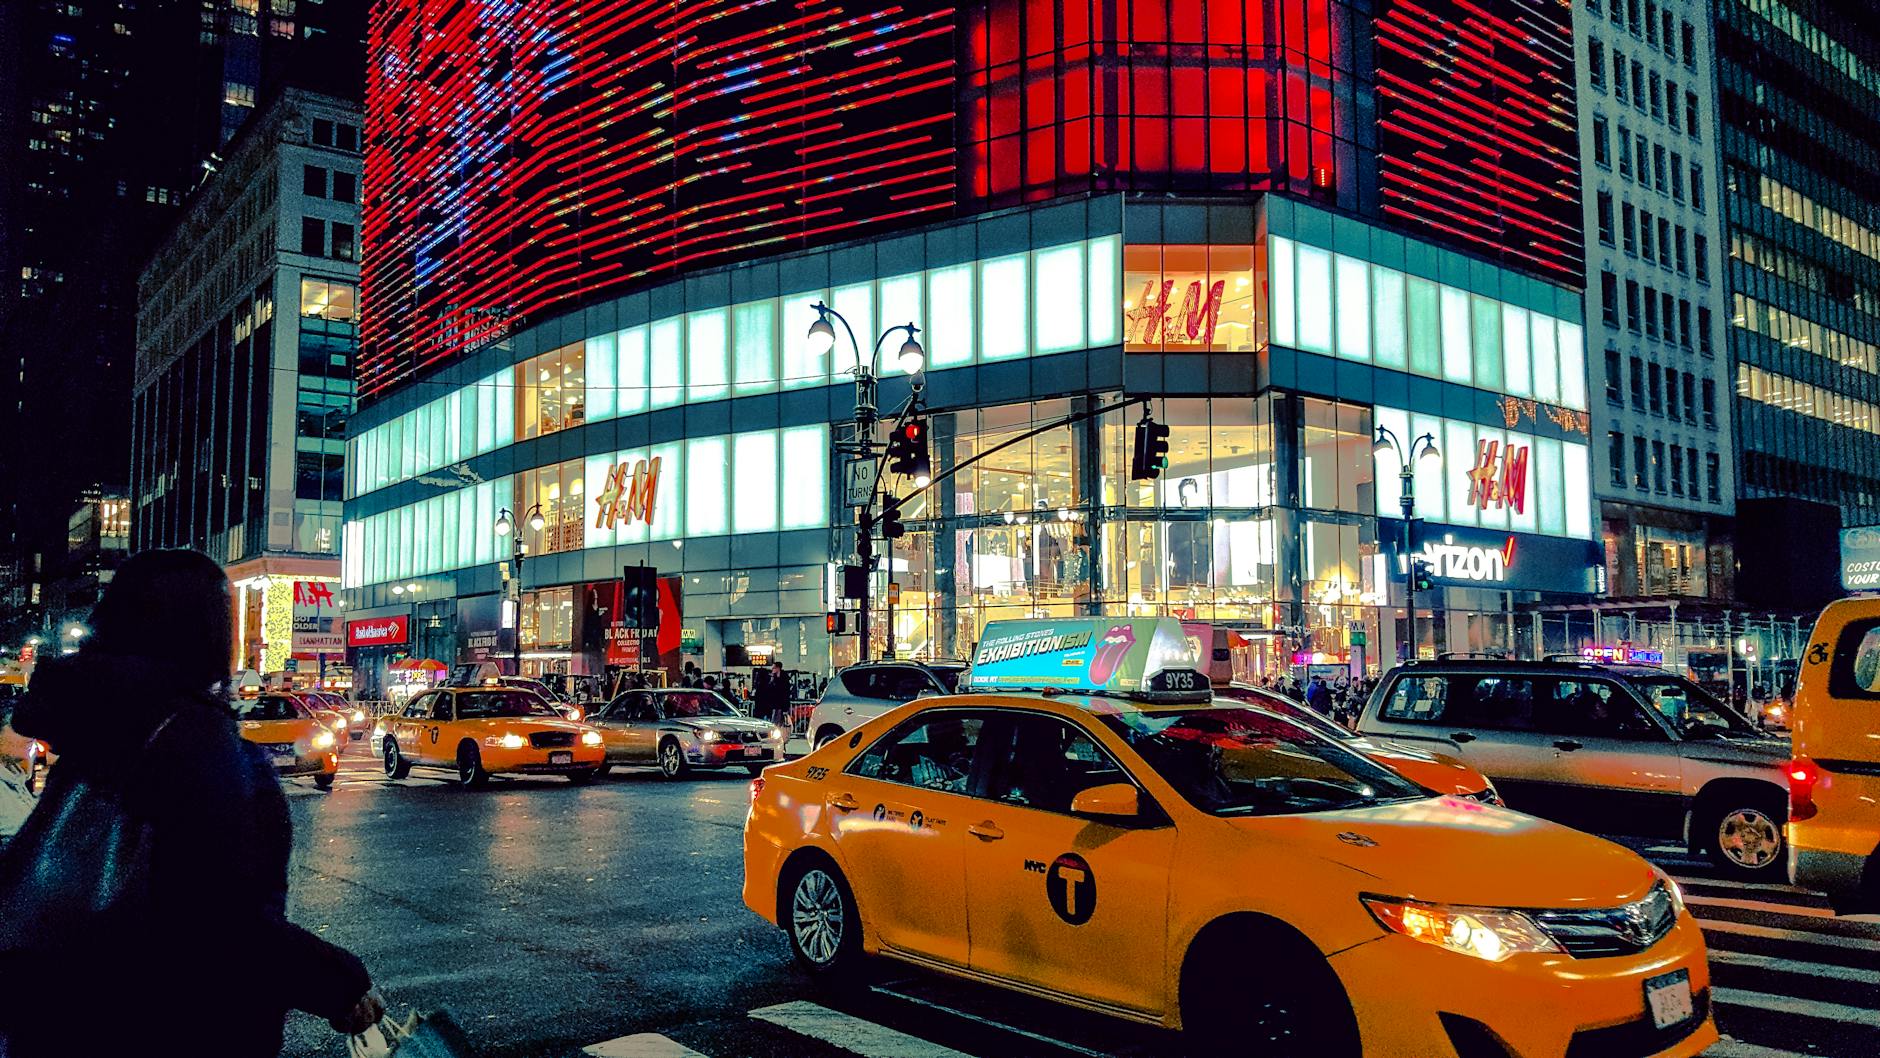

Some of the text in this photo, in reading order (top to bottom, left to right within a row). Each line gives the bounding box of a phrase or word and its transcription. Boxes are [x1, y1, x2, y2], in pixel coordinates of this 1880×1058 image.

[1126, 280, 1225, 344] H&M
[853, 466, 868, 481] NO
[1466, 439, 1528, 515] H&M
[596, 456, 662, 530] H&M
[1847, 573, 1880, 585] YOUR
[605, 626, 658, 640] BLACK FRDAY
[983, 629, 1054, 648] THE ROLLING STONES
[977, 630, 1092, 666] EXHIBITIONISM
[1165, 672, 1194, 689] 9Y35
[1024, 858, 1047, 873] NYC
